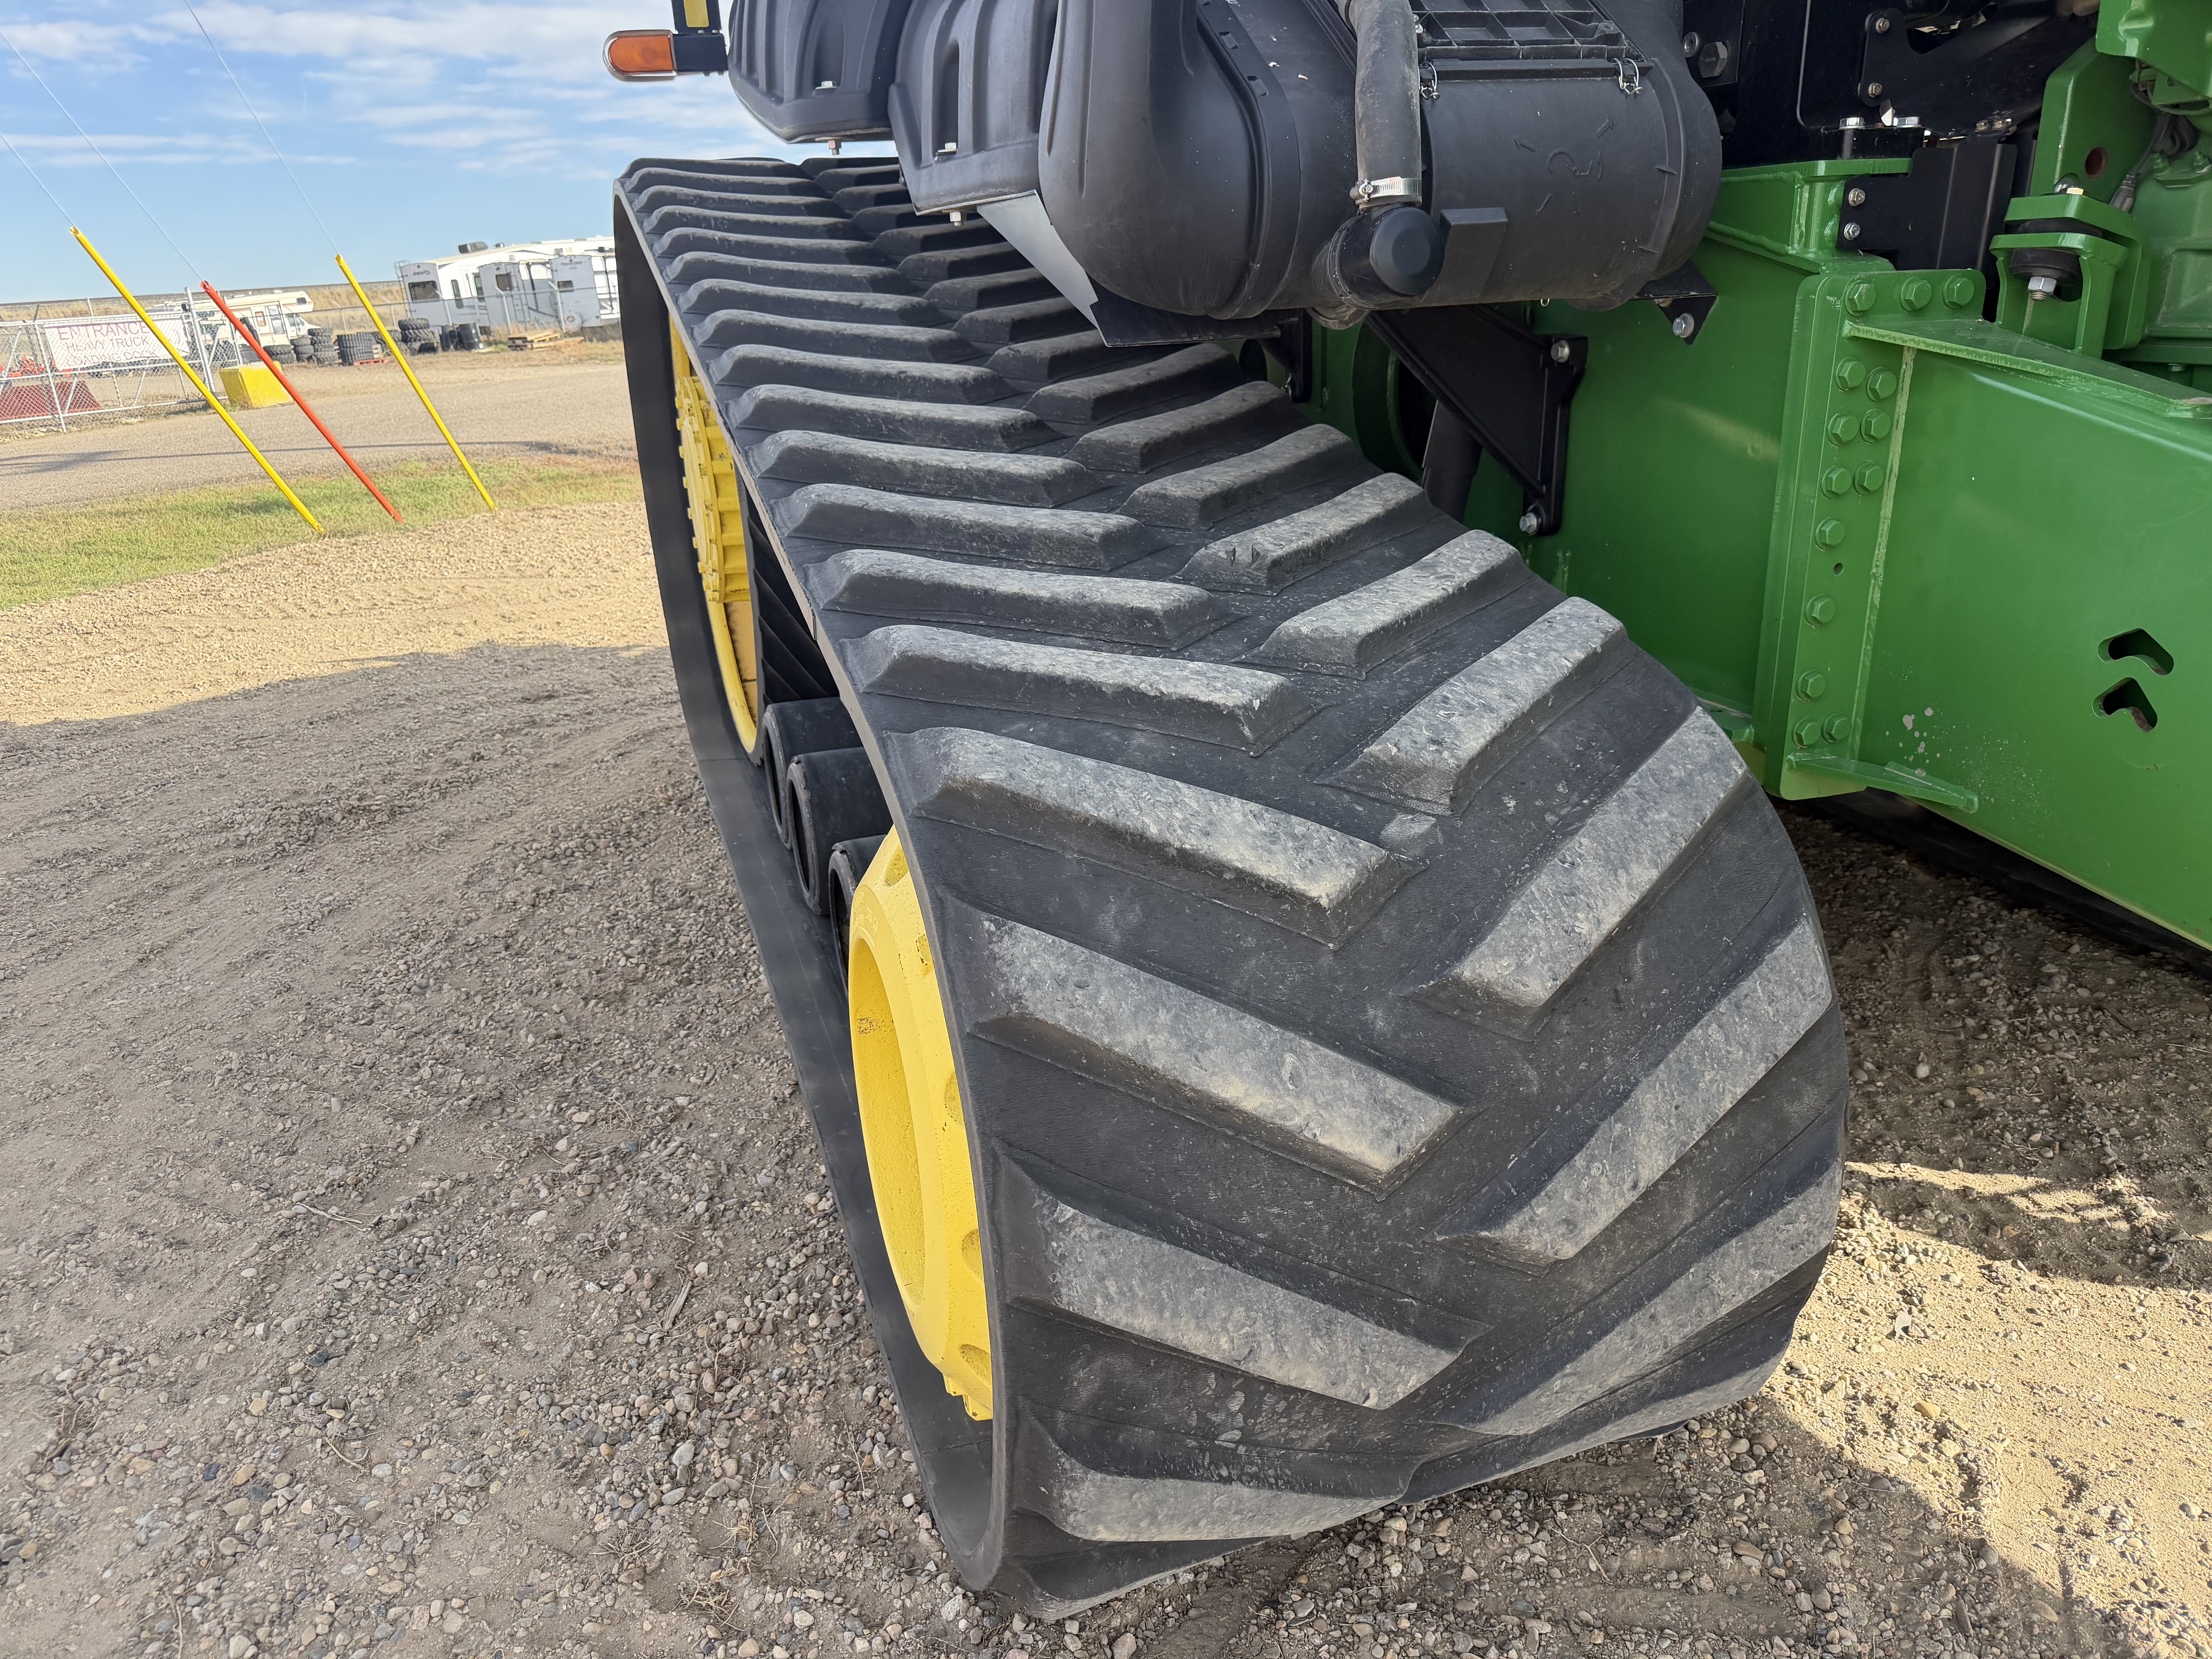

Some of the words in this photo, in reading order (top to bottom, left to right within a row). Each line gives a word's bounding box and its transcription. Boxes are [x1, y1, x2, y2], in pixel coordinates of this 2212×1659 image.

[57, 321, 150, 340] ENTRANCE
[65, 339, 105, 353] HEAVY
[109, 336, 150, 349] TRUCK
[66, 352, 121, 366] LOADING
[124, 350, 160, 361] DOCK
